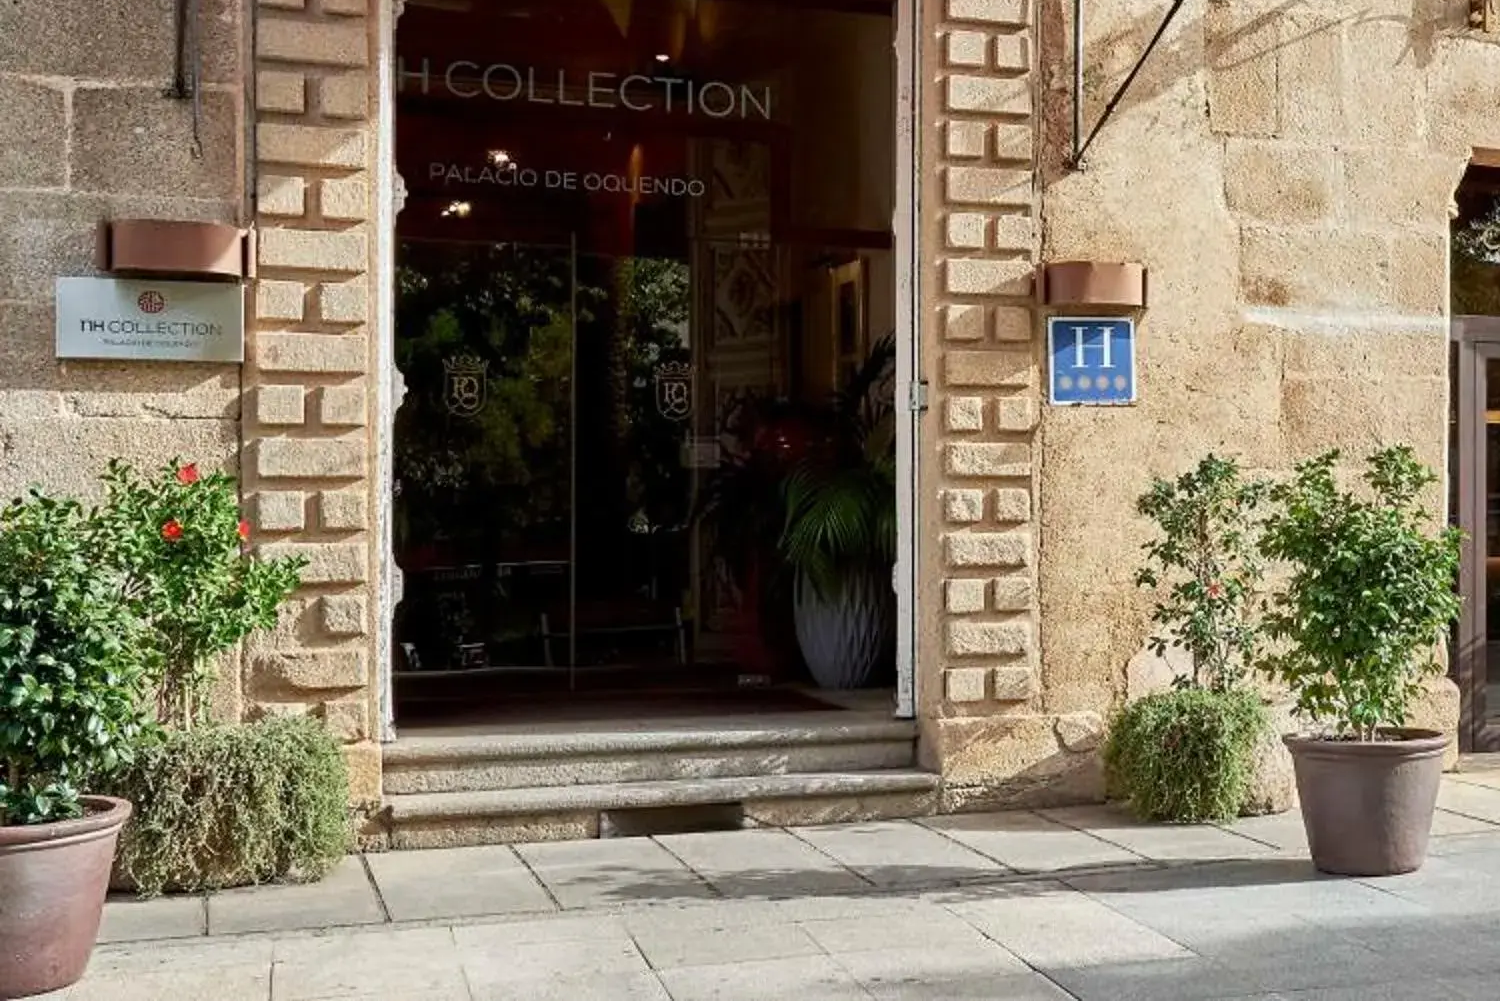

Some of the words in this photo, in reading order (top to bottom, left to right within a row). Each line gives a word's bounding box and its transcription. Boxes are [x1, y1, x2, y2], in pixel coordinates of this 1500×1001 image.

[445, 60, 771, 120] COLLECTION
[428, 161, 538, 187] PALACIO
[545, 169, 578, 191] DE
[583, 172, 706, 198] OQUENDO
[107, 319, 223, 337] COLLECTION
[1070, 325, 1117, 369] H
